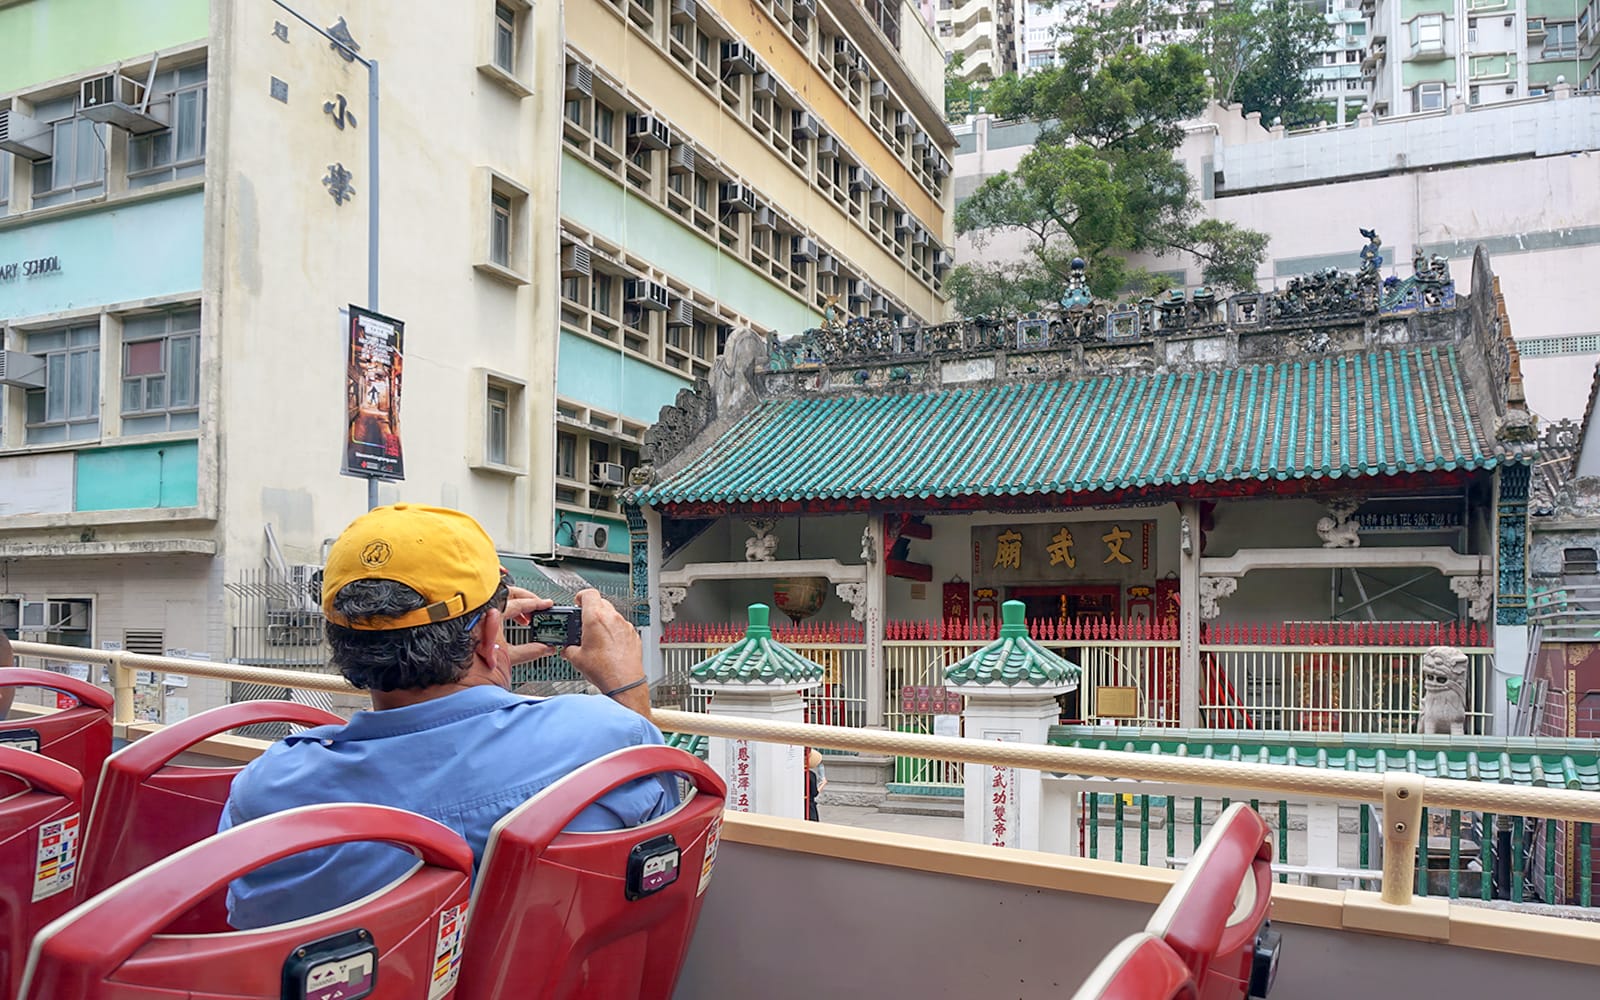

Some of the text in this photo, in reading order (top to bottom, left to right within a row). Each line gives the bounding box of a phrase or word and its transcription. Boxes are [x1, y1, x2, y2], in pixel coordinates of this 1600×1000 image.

[22, 255, 62, 277] SCHOOL
[992, 525, 1133, 570] 文武廟
[736, 739, 750, 813] 恩聖澤五
[991, 738, 1008, 848] 武功雙帝
